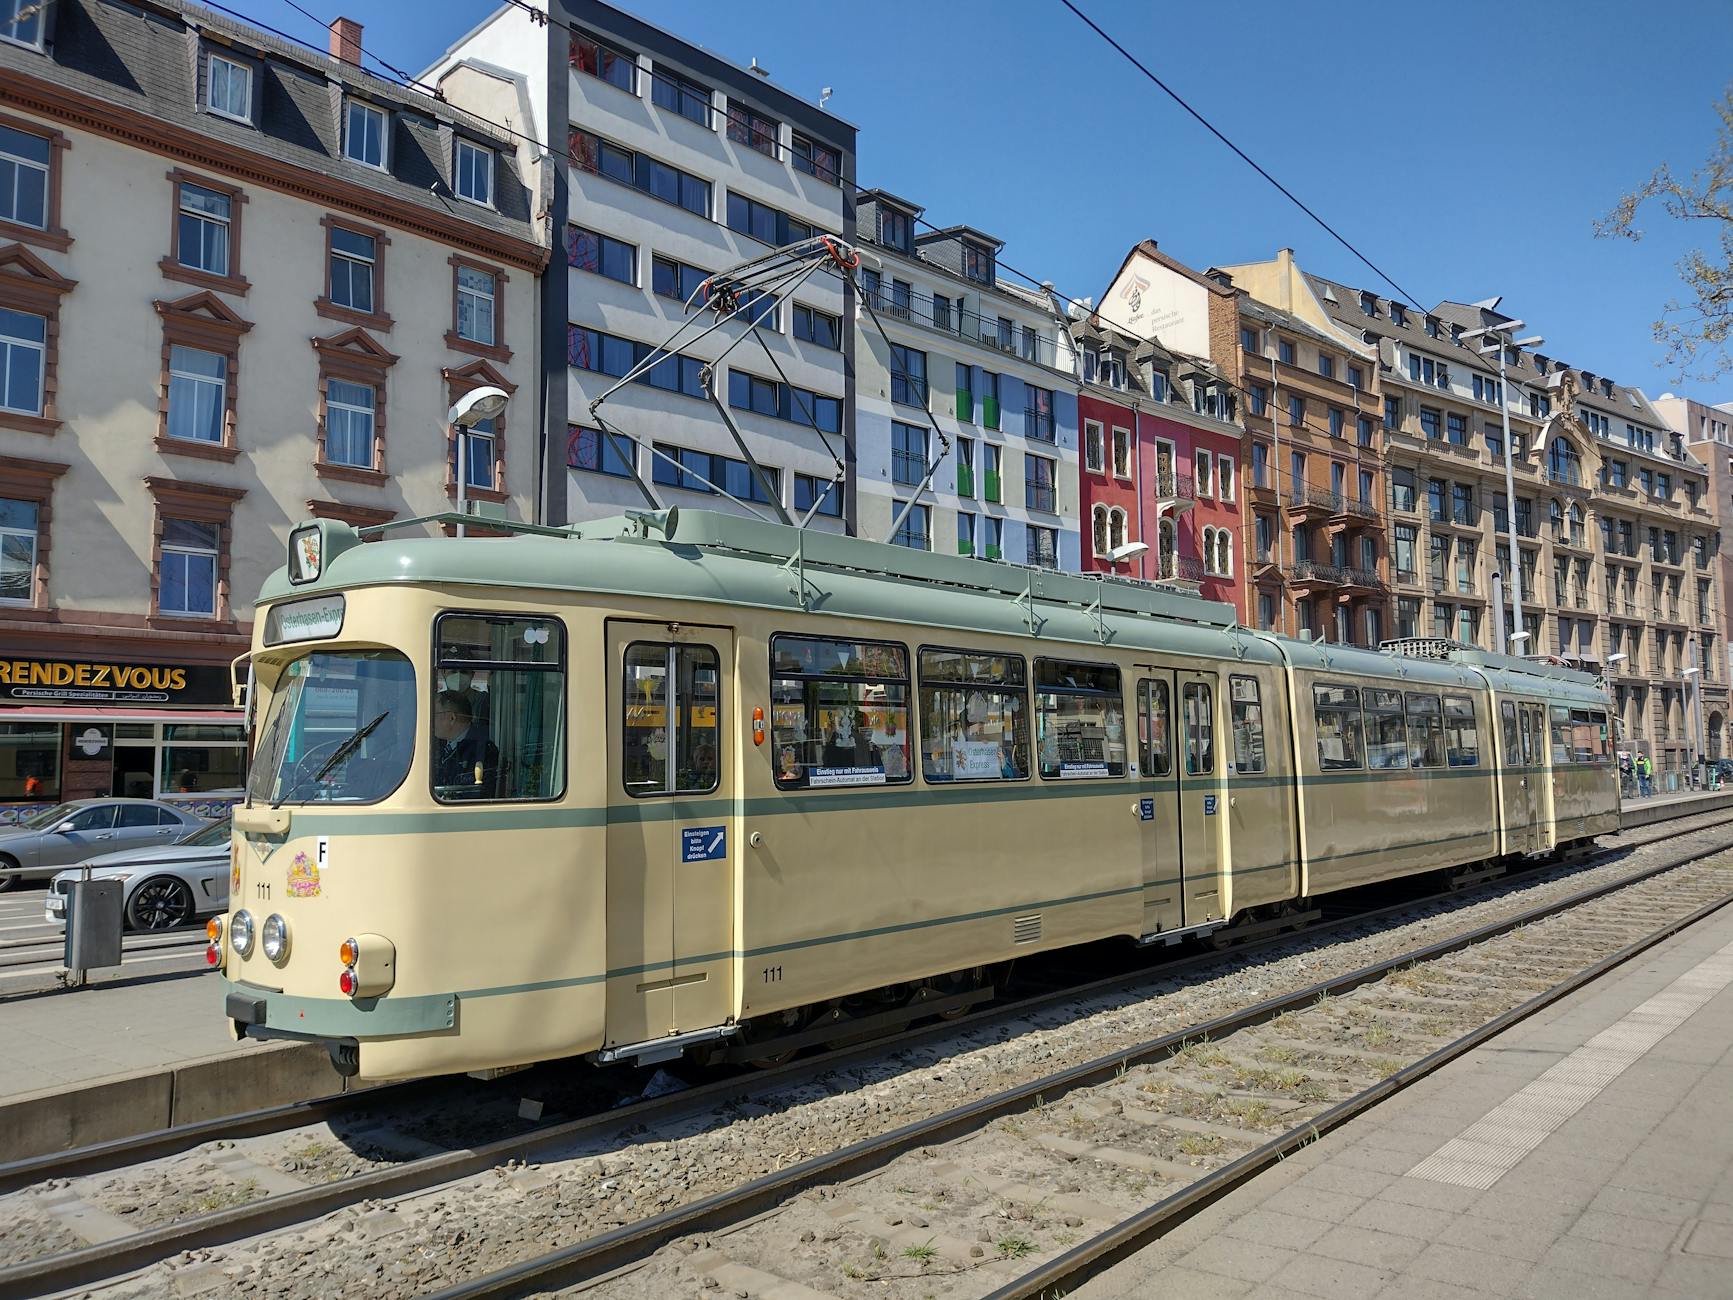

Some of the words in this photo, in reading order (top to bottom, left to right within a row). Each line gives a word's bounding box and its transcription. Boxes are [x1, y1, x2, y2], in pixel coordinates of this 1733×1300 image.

[0, 661, 187, 690] RENDEZVOUS
[22, 689, 53, 698] Persische
[53, 690, 68, 698] Grill
[68, 691, 109, 699] Spezialitäten
[816, 768, 836, 776] Einstieg
[844, 767, 852, 775] mit
[684, 830, 710, 838] Einsteigen
[319, 842, 326, 862] F
[689, 845, 705, 853] Knopf
[257, 882, 271, 900] 111
[762, 965, 782, 983] 111
